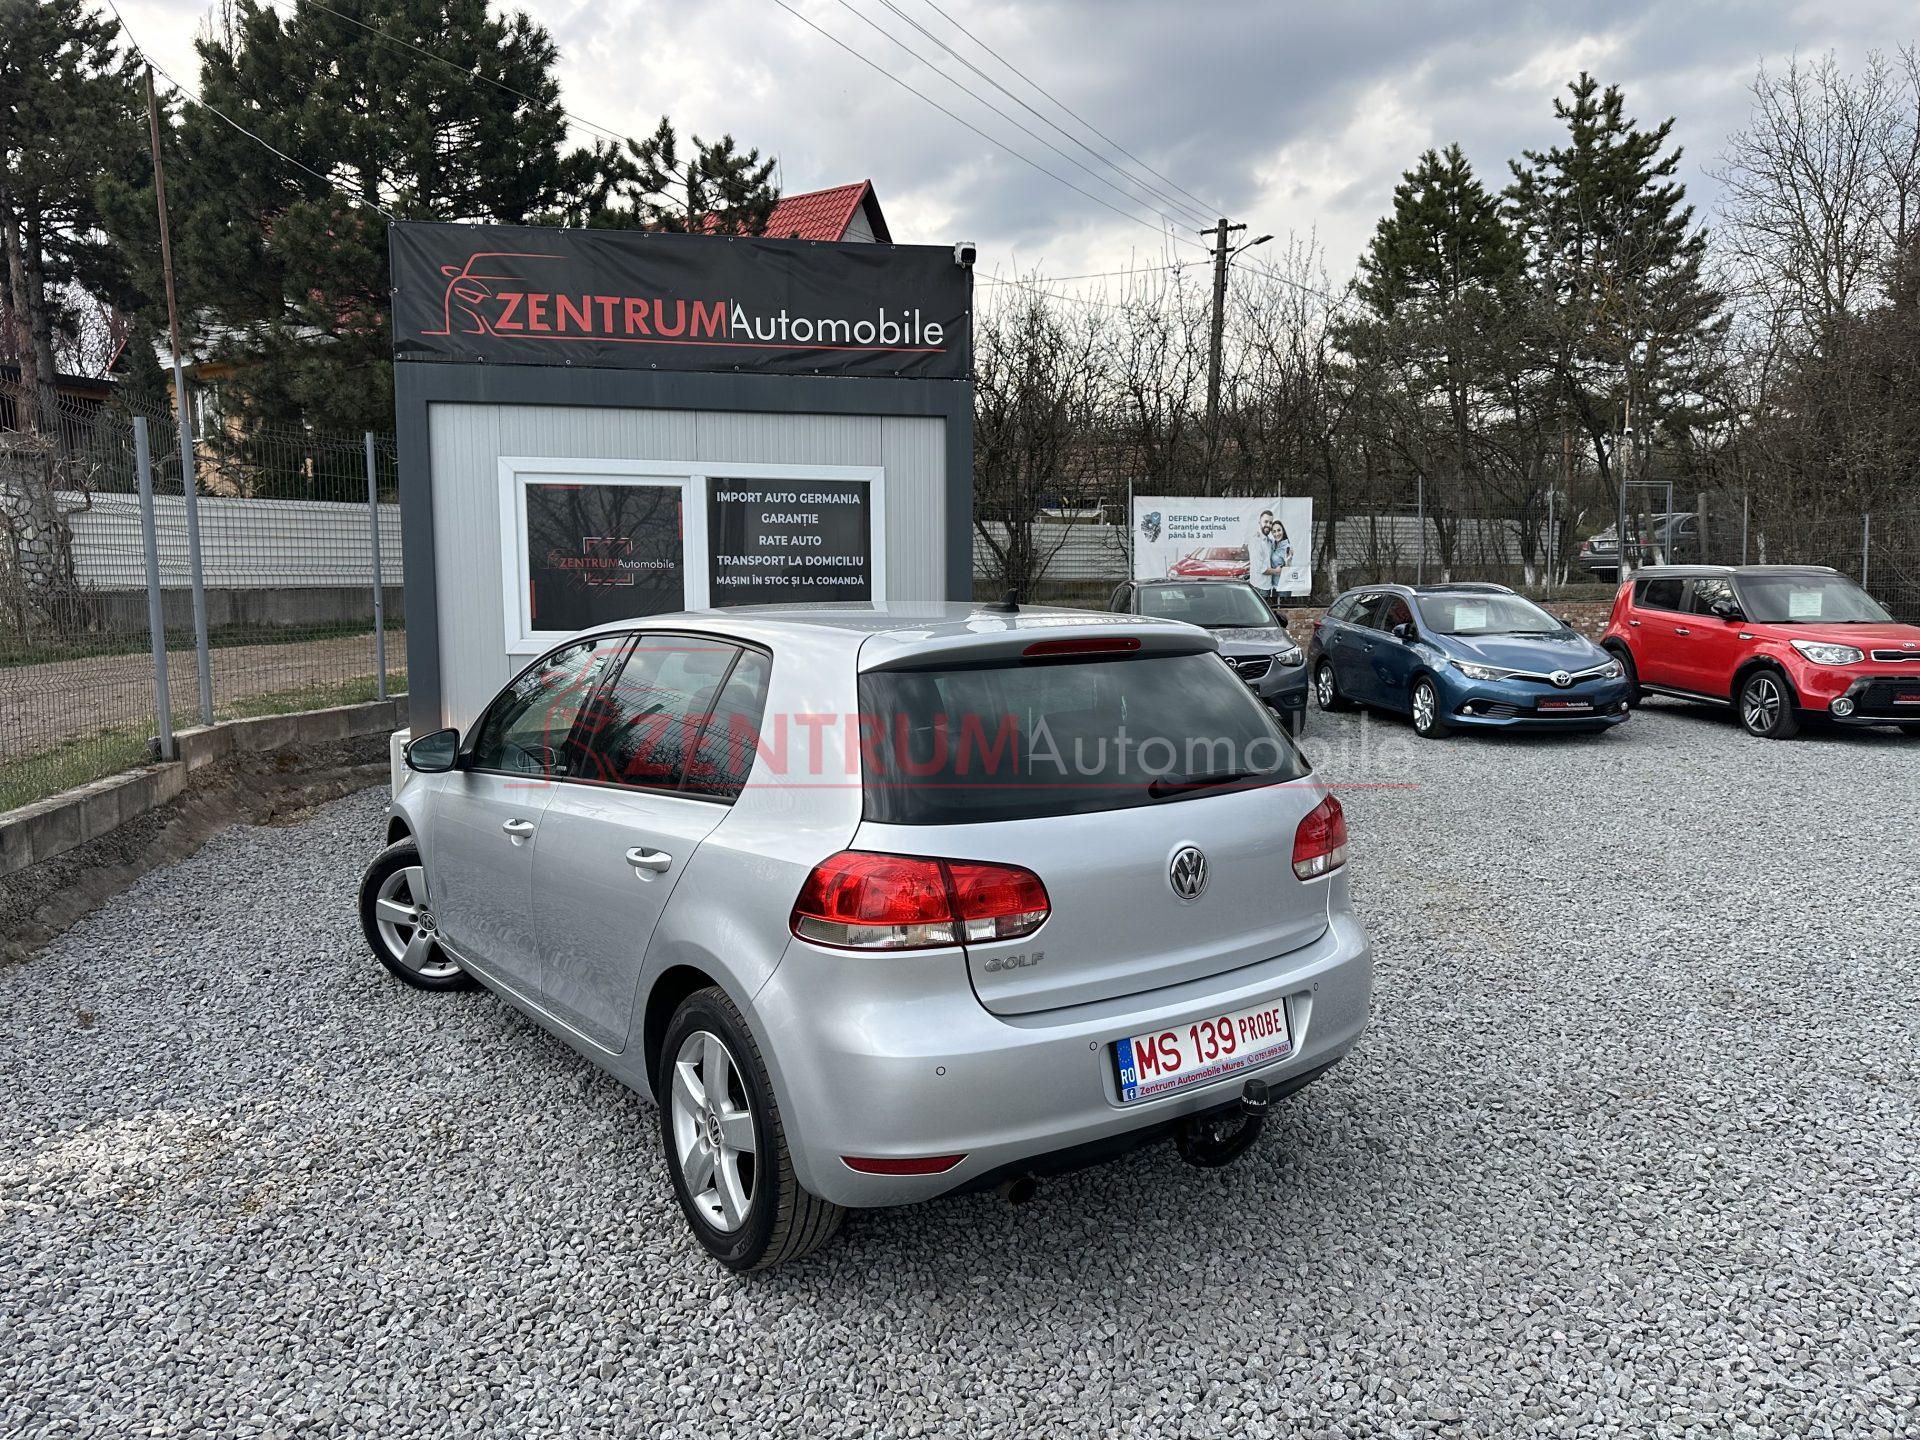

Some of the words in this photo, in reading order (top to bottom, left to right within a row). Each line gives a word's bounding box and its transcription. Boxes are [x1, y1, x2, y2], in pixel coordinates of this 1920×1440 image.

[495, 292, 727, 338] ZENTRUM
[732, 301, 944, 346] Automobile
[717, 491, 762, 503] IMPORT
[765, 492, 797, 503] AUTO
[800, 493, 861, 504] GERMANIA
[761, 513, 819, 526] GARANȚIE
[759, 535, 788, 546] RATE
[790, 536, 822, 546] AUTO
[560, 557, 619, 569] ZENTRUM
[618, 558, 675, 569] Automobile
[717, 555, 786, 566] TRANSPORT
[788, 556, 802, 566] LA
[805, 556, 864, 566] DOMICILIU
[716, 575, 750, 587] MAȘINI
[752, 574, 763, 585] ÎN
[764, 576, 789, 585] STOC
[791, 576, 800, 587] ȘI
[802, 576, 814, 585] LA
[816, 575, 865, 585] COMANDĂ
[984, 951, 1045, 973] GOLF
[1135, 1032, 1181, 1080] MS
[1190, 1017, 1236, 1063] 139
[1238, 1008, 1282, 1043] PROBE
[1120, 1068, 1136, 1086] RO
[1140, 1081, 1176, 1096] Zentrum
[1178, 1067, 1221, 1085] Automobile
[1222, 1059, 1245, 1073] Mures
